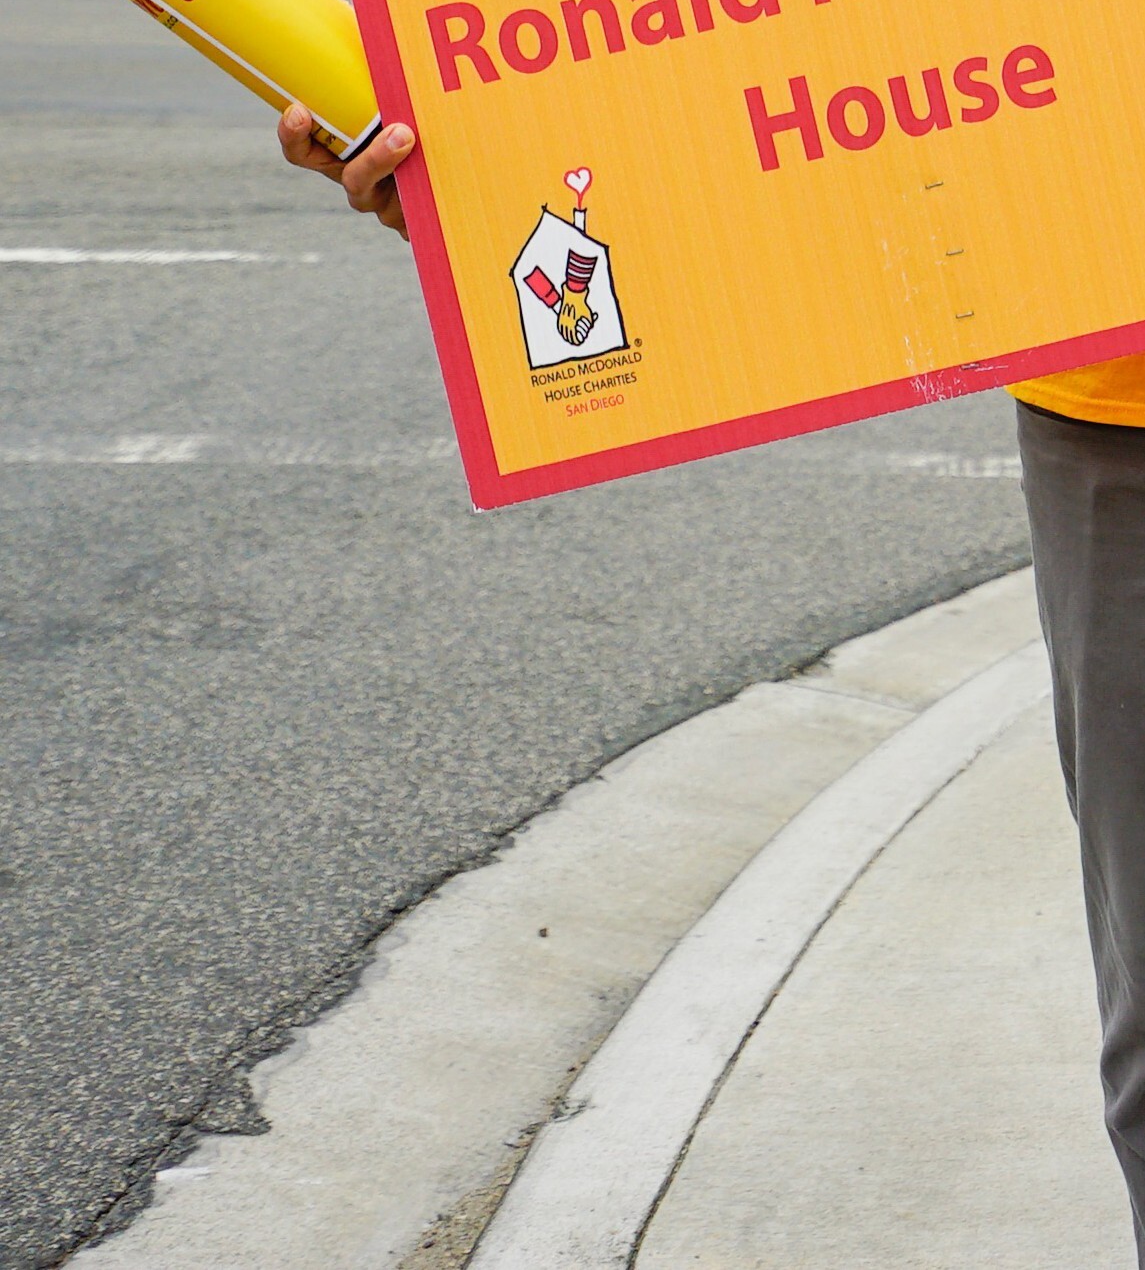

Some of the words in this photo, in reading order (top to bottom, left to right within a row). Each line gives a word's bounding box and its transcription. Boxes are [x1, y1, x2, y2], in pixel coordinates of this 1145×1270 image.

[743, 43, 1058, 172] House
[530, 367, 576, 388] RONALD
[544, 384, 582, 403] HOUSE
[583, 371, 638, 394] CHARITIES
[565, 402, 589, 417] SAN
[590, 394, 625, 412] DIEGO
